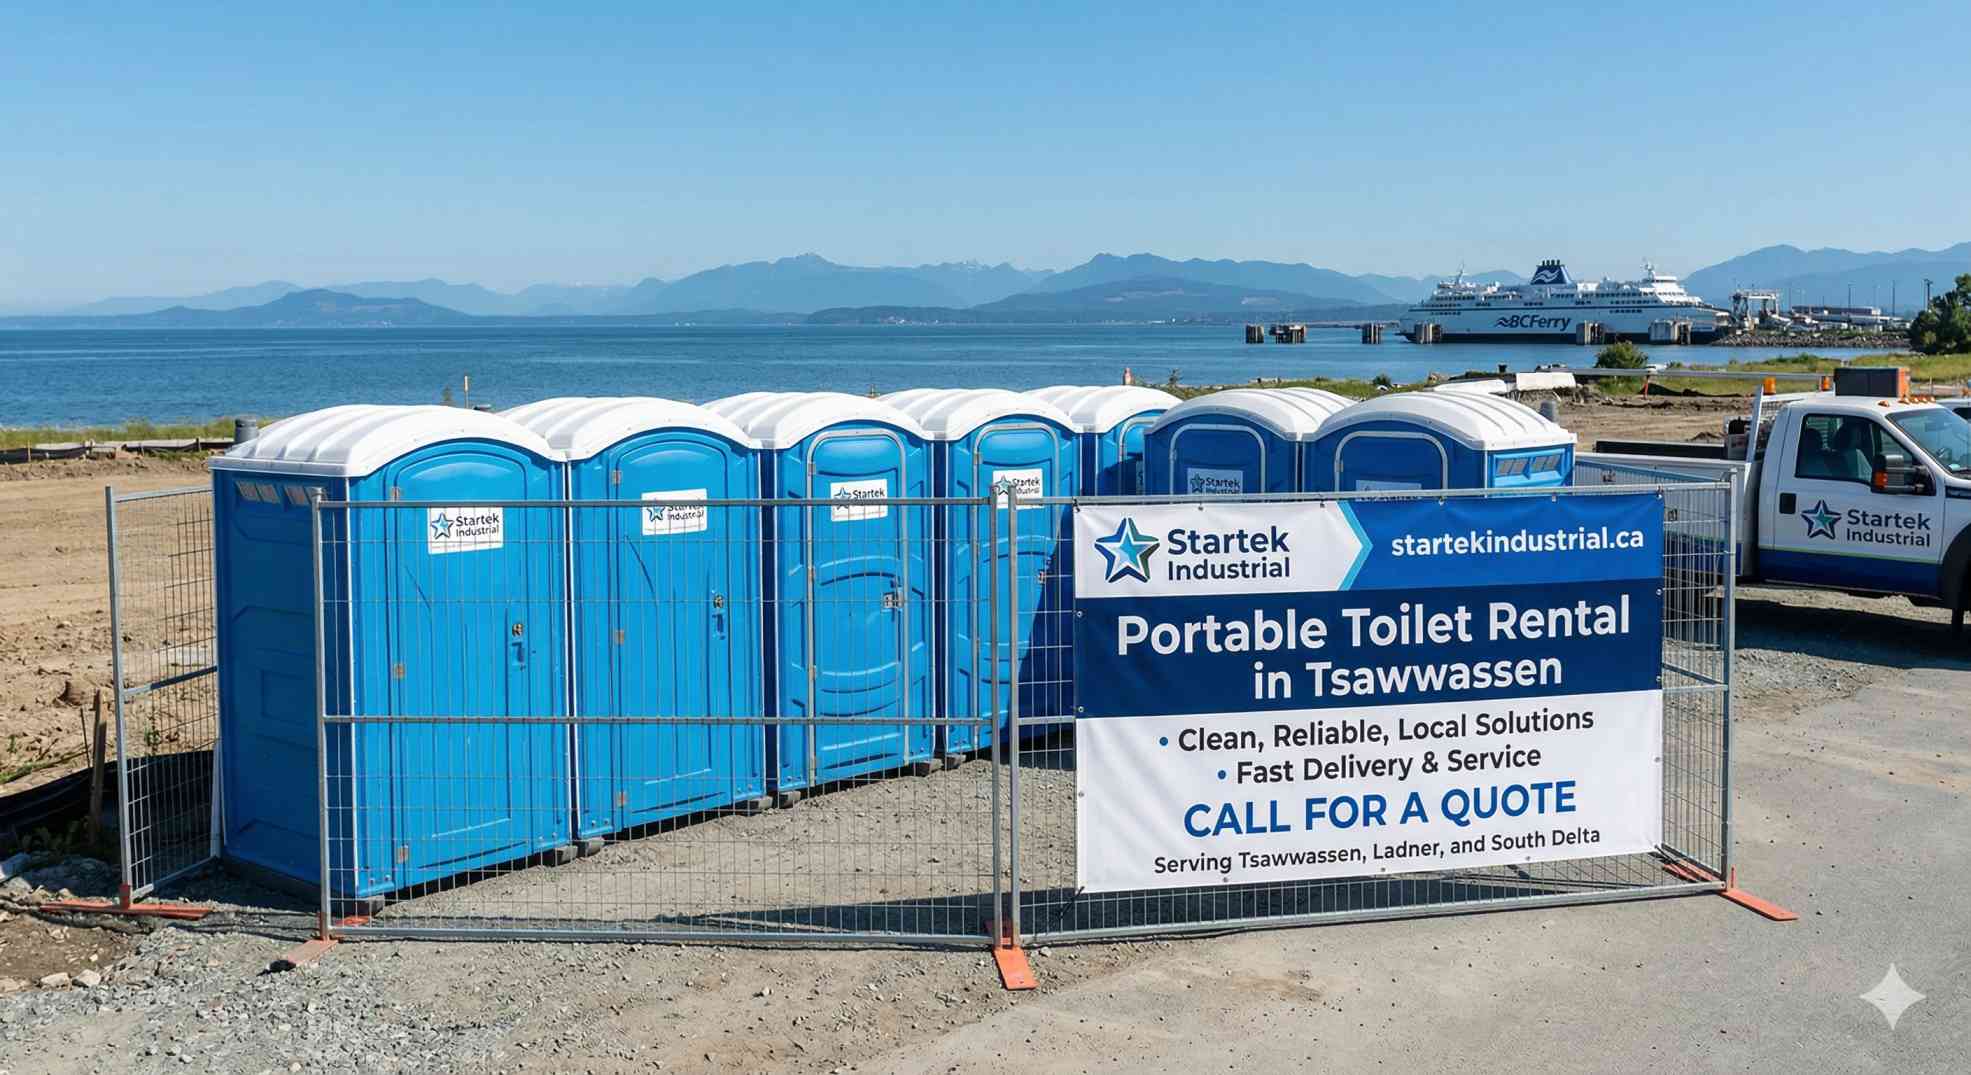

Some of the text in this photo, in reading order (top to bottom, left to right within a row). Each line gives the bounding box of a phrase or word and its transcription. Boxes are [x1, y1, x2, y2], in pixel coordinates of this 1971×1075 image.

[1509, 315, 1571, 331] BCFerry
[852, 488, 886, 499] Startek
[1205, 477, 1241, 488] Startek
[456, 513, 500, 527] Startek
[456, 524, 500, 537] Industrial
[1847, 509, 1931, 531] Startek
[1167, 525, 1290, 555] Startek
[1391, 527, 1644, 557] startekindustrial.ca
[1847, 529, 1930, 547] Industrial
[1168, 557, 1290, 581] Industrial
[1117, 594, 1630, 656] Portable Toilet Rental
[1254, 657, 1562, 700] in Tsawwassen
[1178, 708, 1595, 752] Clean, Reliable, Local Solutions
[1237, 744, 1542, 784] Fast Delivery & Service
[1184, 780, 1577, 838] CALL FOR A QUOTE
[1154, 827, 1601, 874] Serving Tsawwassen, Ladner, and South Delta
